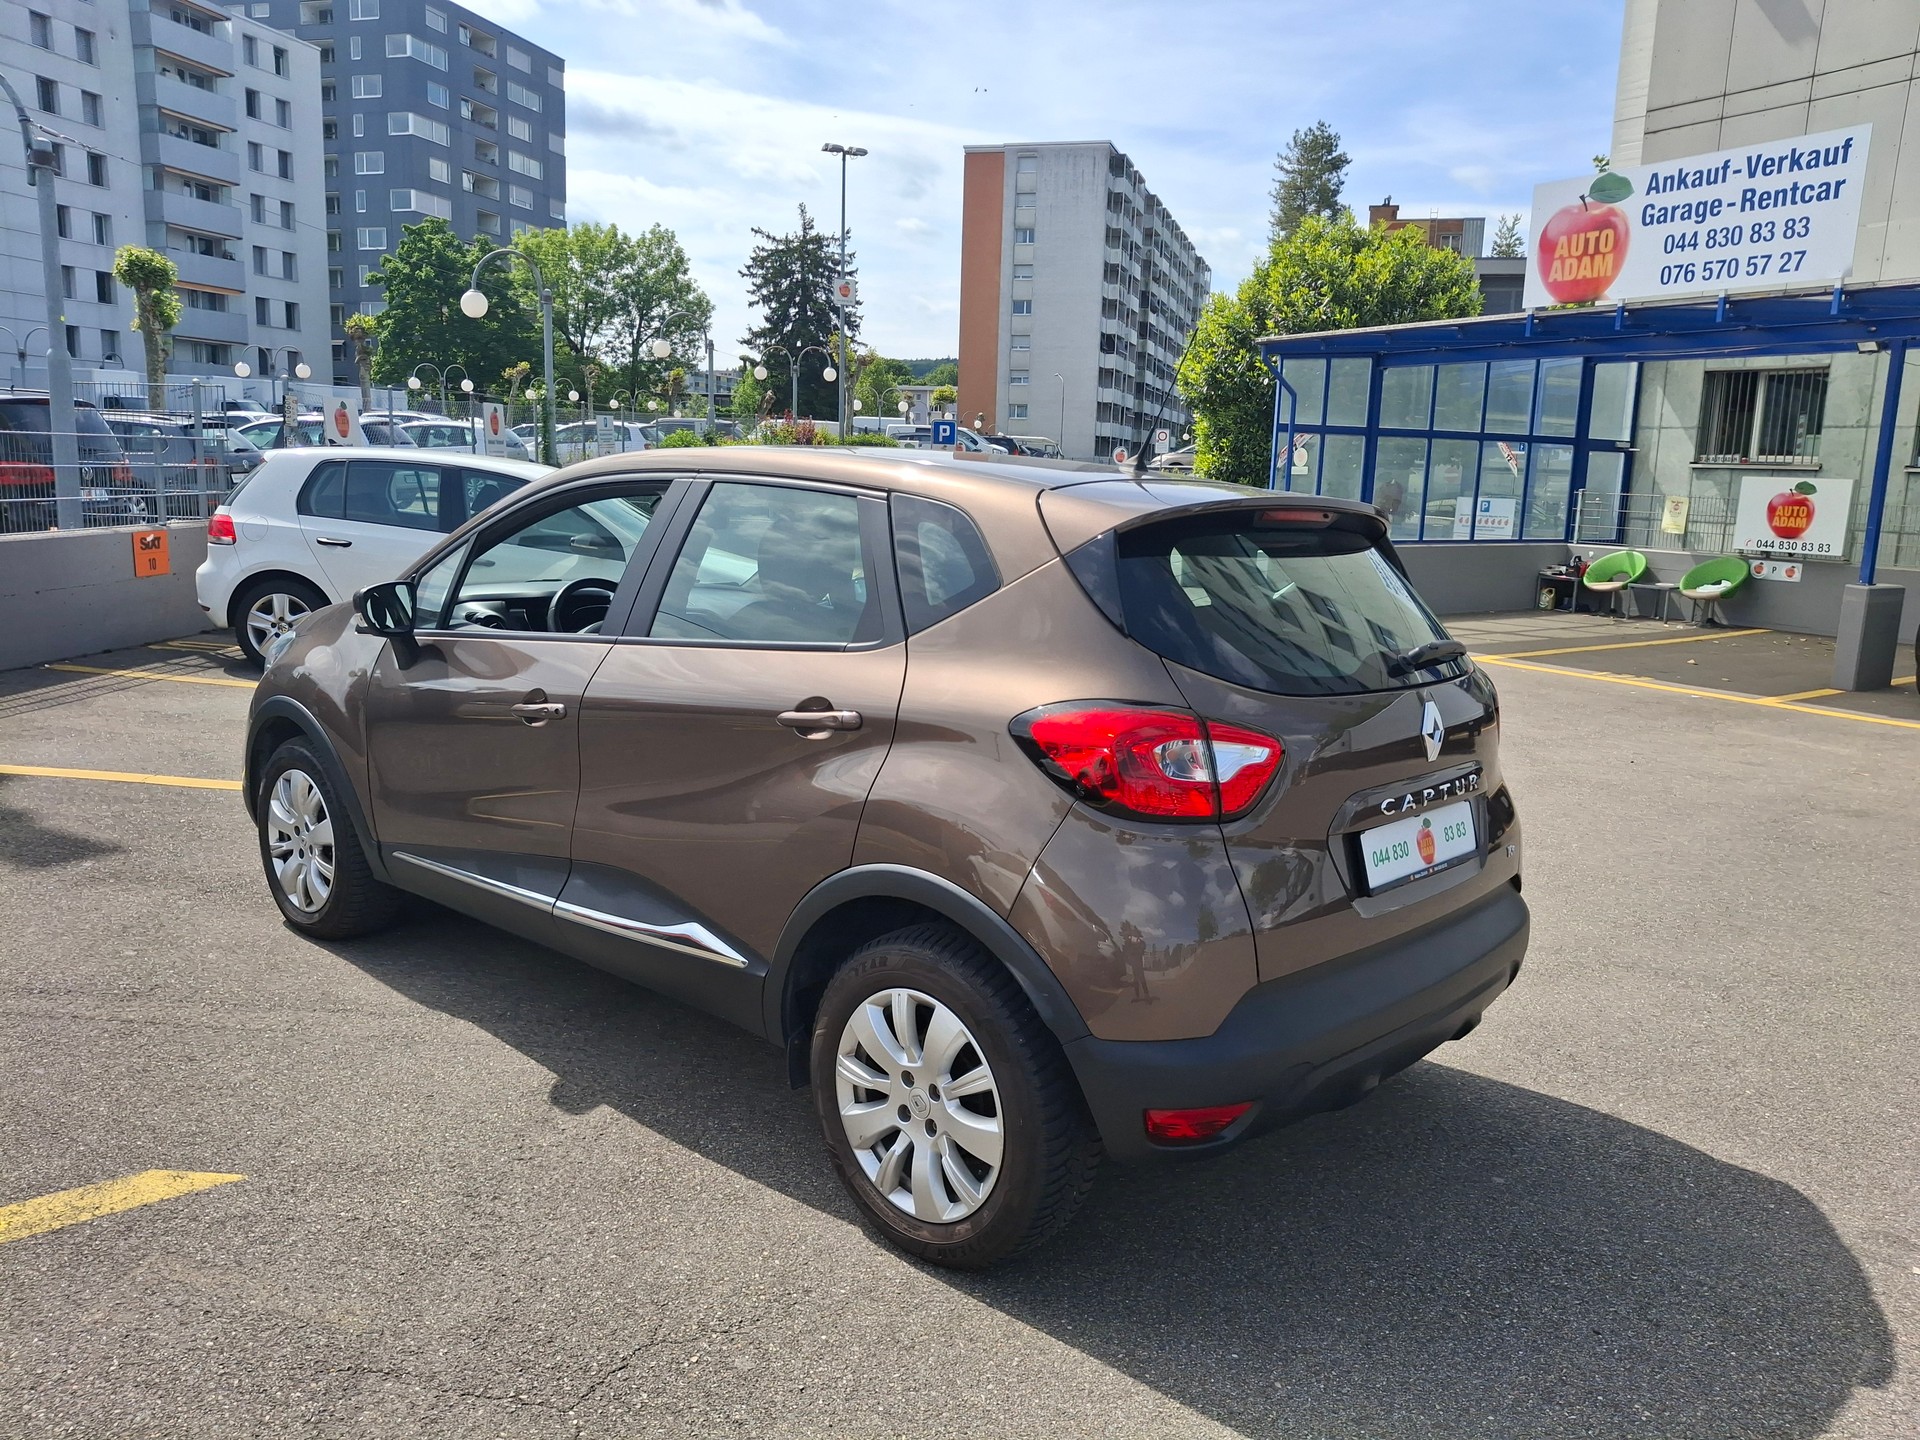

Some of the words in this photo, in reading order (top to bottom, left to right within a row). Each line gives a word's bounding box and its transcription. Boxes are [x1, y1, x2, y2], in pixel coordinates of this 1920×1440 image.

[1645, 137, 1853, 196] Ankauf-Verkauf
[1641, 178, 1847, 226] Garage-Rentcar
[1554, 228, 1614, 258] AUTO
[1664, 231, 1699, 254] 044
[1705, 225, 1743, 250] 830
[1749, 220, 1775, 244] 83
[1782, 216, 1811, 239] 83
[1548, 254, 1613, 283] ADAM
[1660, 262, 1696, 286] 076
[1701, 258, 1739, 282] 570
[1745, 254, 1773, 277] 57
[1779, 250, 1807, 274] 27
[939, 425, 951, 442] P
[1481, 502, 1489, 511] P
[1776, 505, 1808, 517] AUTO
[1772, 516, 1807, 528] ADAM
[1756, 539, 1775, 549] 044
[1778, 541, 1798, 551] 830
[1801, 542, 1814, 552] 83
[1817, 543, 1831, 553] 83
[148, 557, 157, 570] 10
[1772, 566, 1777, 574] P
[1381, 774, 1479, 816] CAPTUR
[1443, 824, 1455, 842] 83
[1456, 821, 1467, 839] 83
[1372, 847, 1391, 868] 044
[1392, 840, 1410, 861] 830
